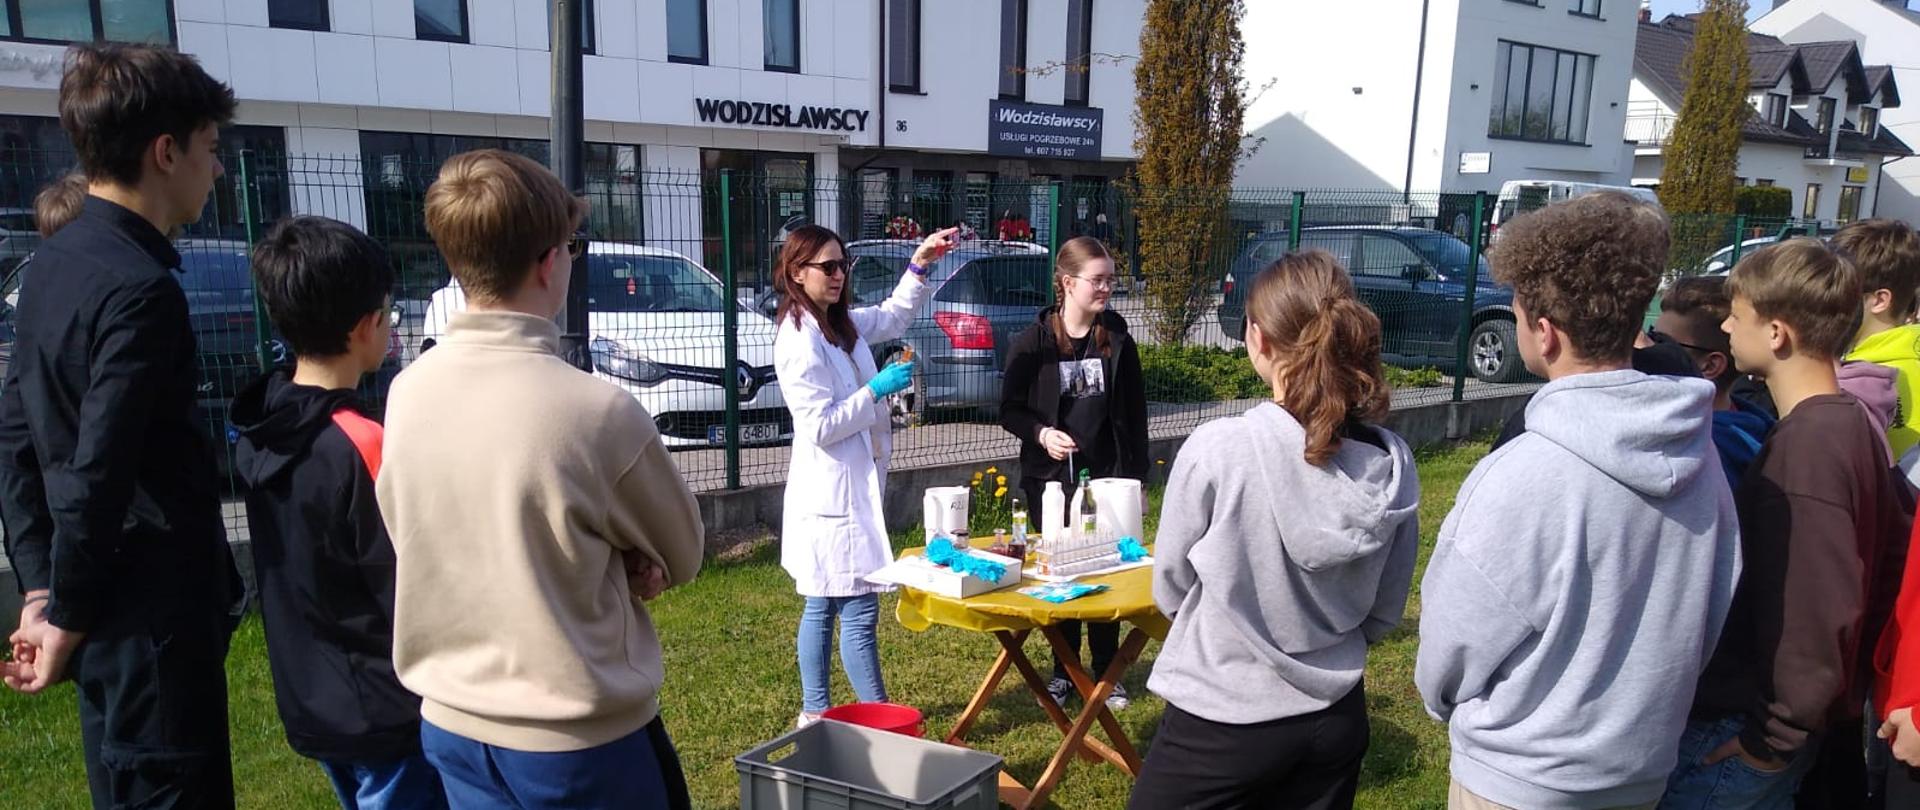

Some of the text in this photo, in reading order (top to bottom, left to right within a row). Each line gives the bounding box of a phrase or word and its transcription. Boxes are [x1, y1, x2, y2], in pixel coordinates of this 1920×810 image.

[696, 98, 869, 131] WODZISŁAWSCY
[999, 107, 1096, 131] Wodzisławscy
[896, 119, 908, 132] 36
[1000, 132, 1028, 142] USŁUGI
[1029, 134, 1081, 146] POGRZEBOWE
